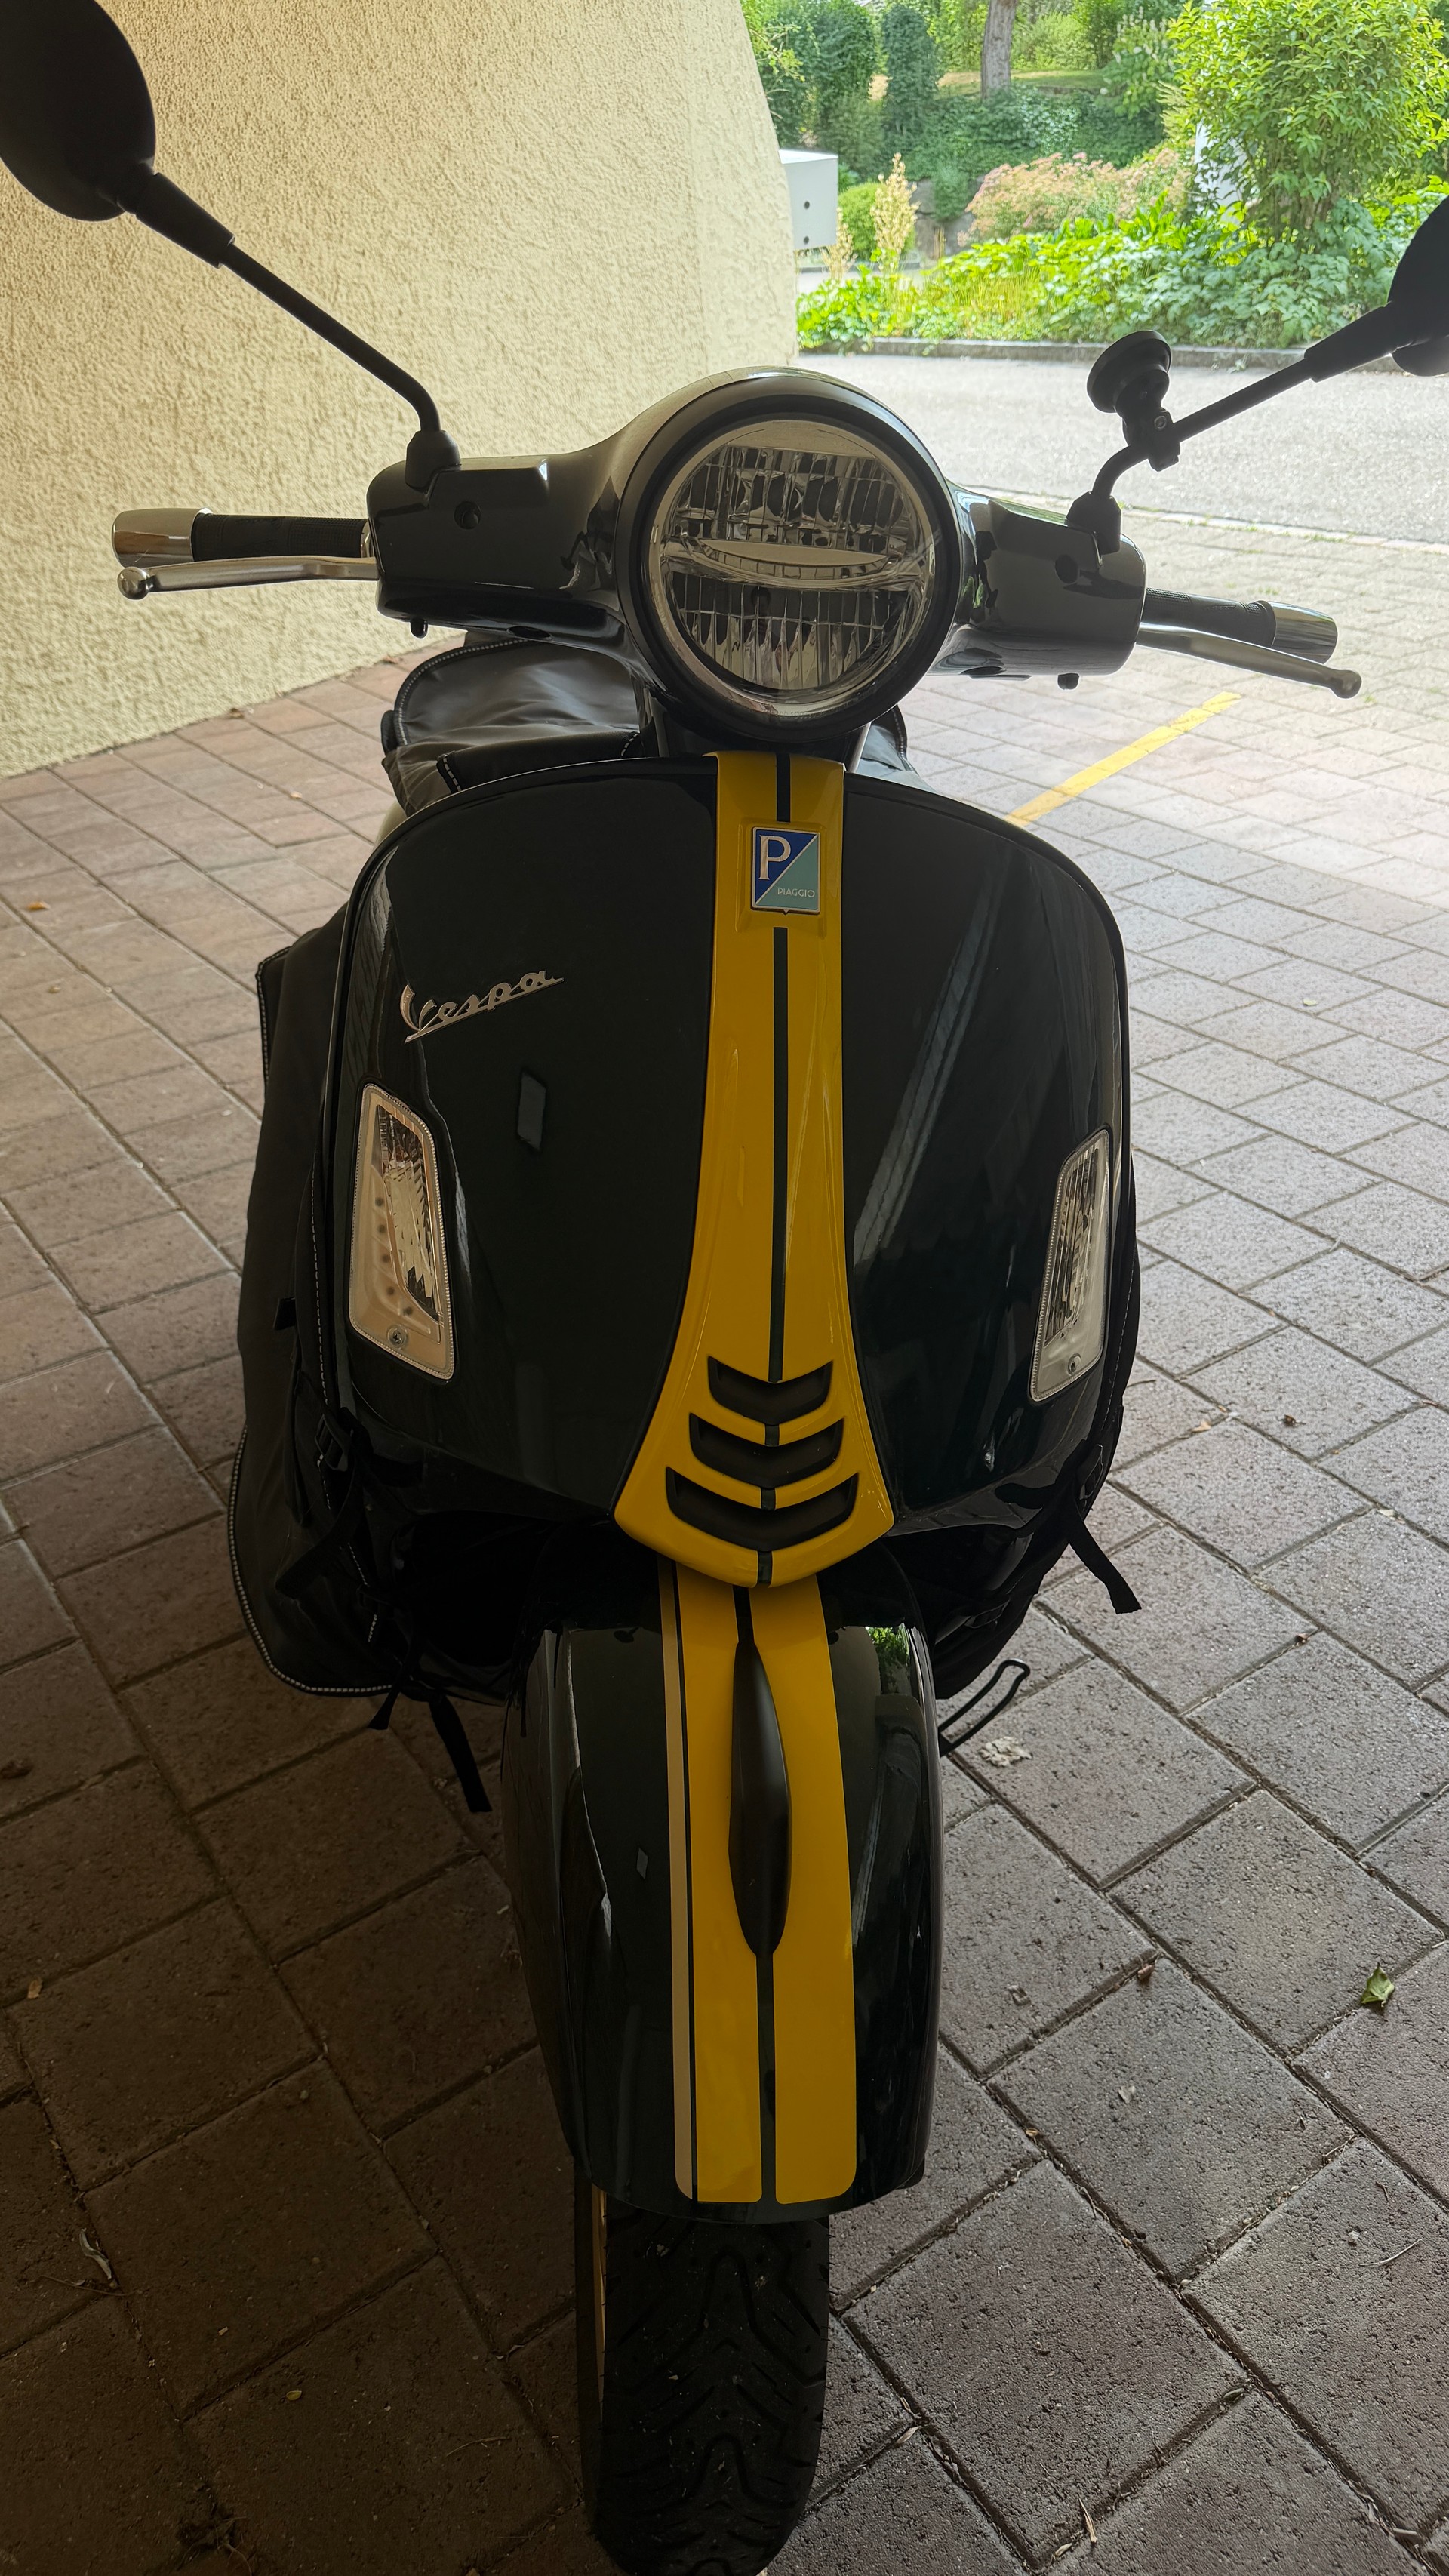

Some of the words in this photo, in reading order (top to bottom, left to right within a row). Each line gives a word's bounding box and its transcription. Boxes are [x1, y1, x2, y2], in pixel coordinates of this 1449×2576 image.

[758, 834, 792, 880] P
[777, 887, 815, 898] PIAGGIO
[400, 971, 565, 1044] Vespa
